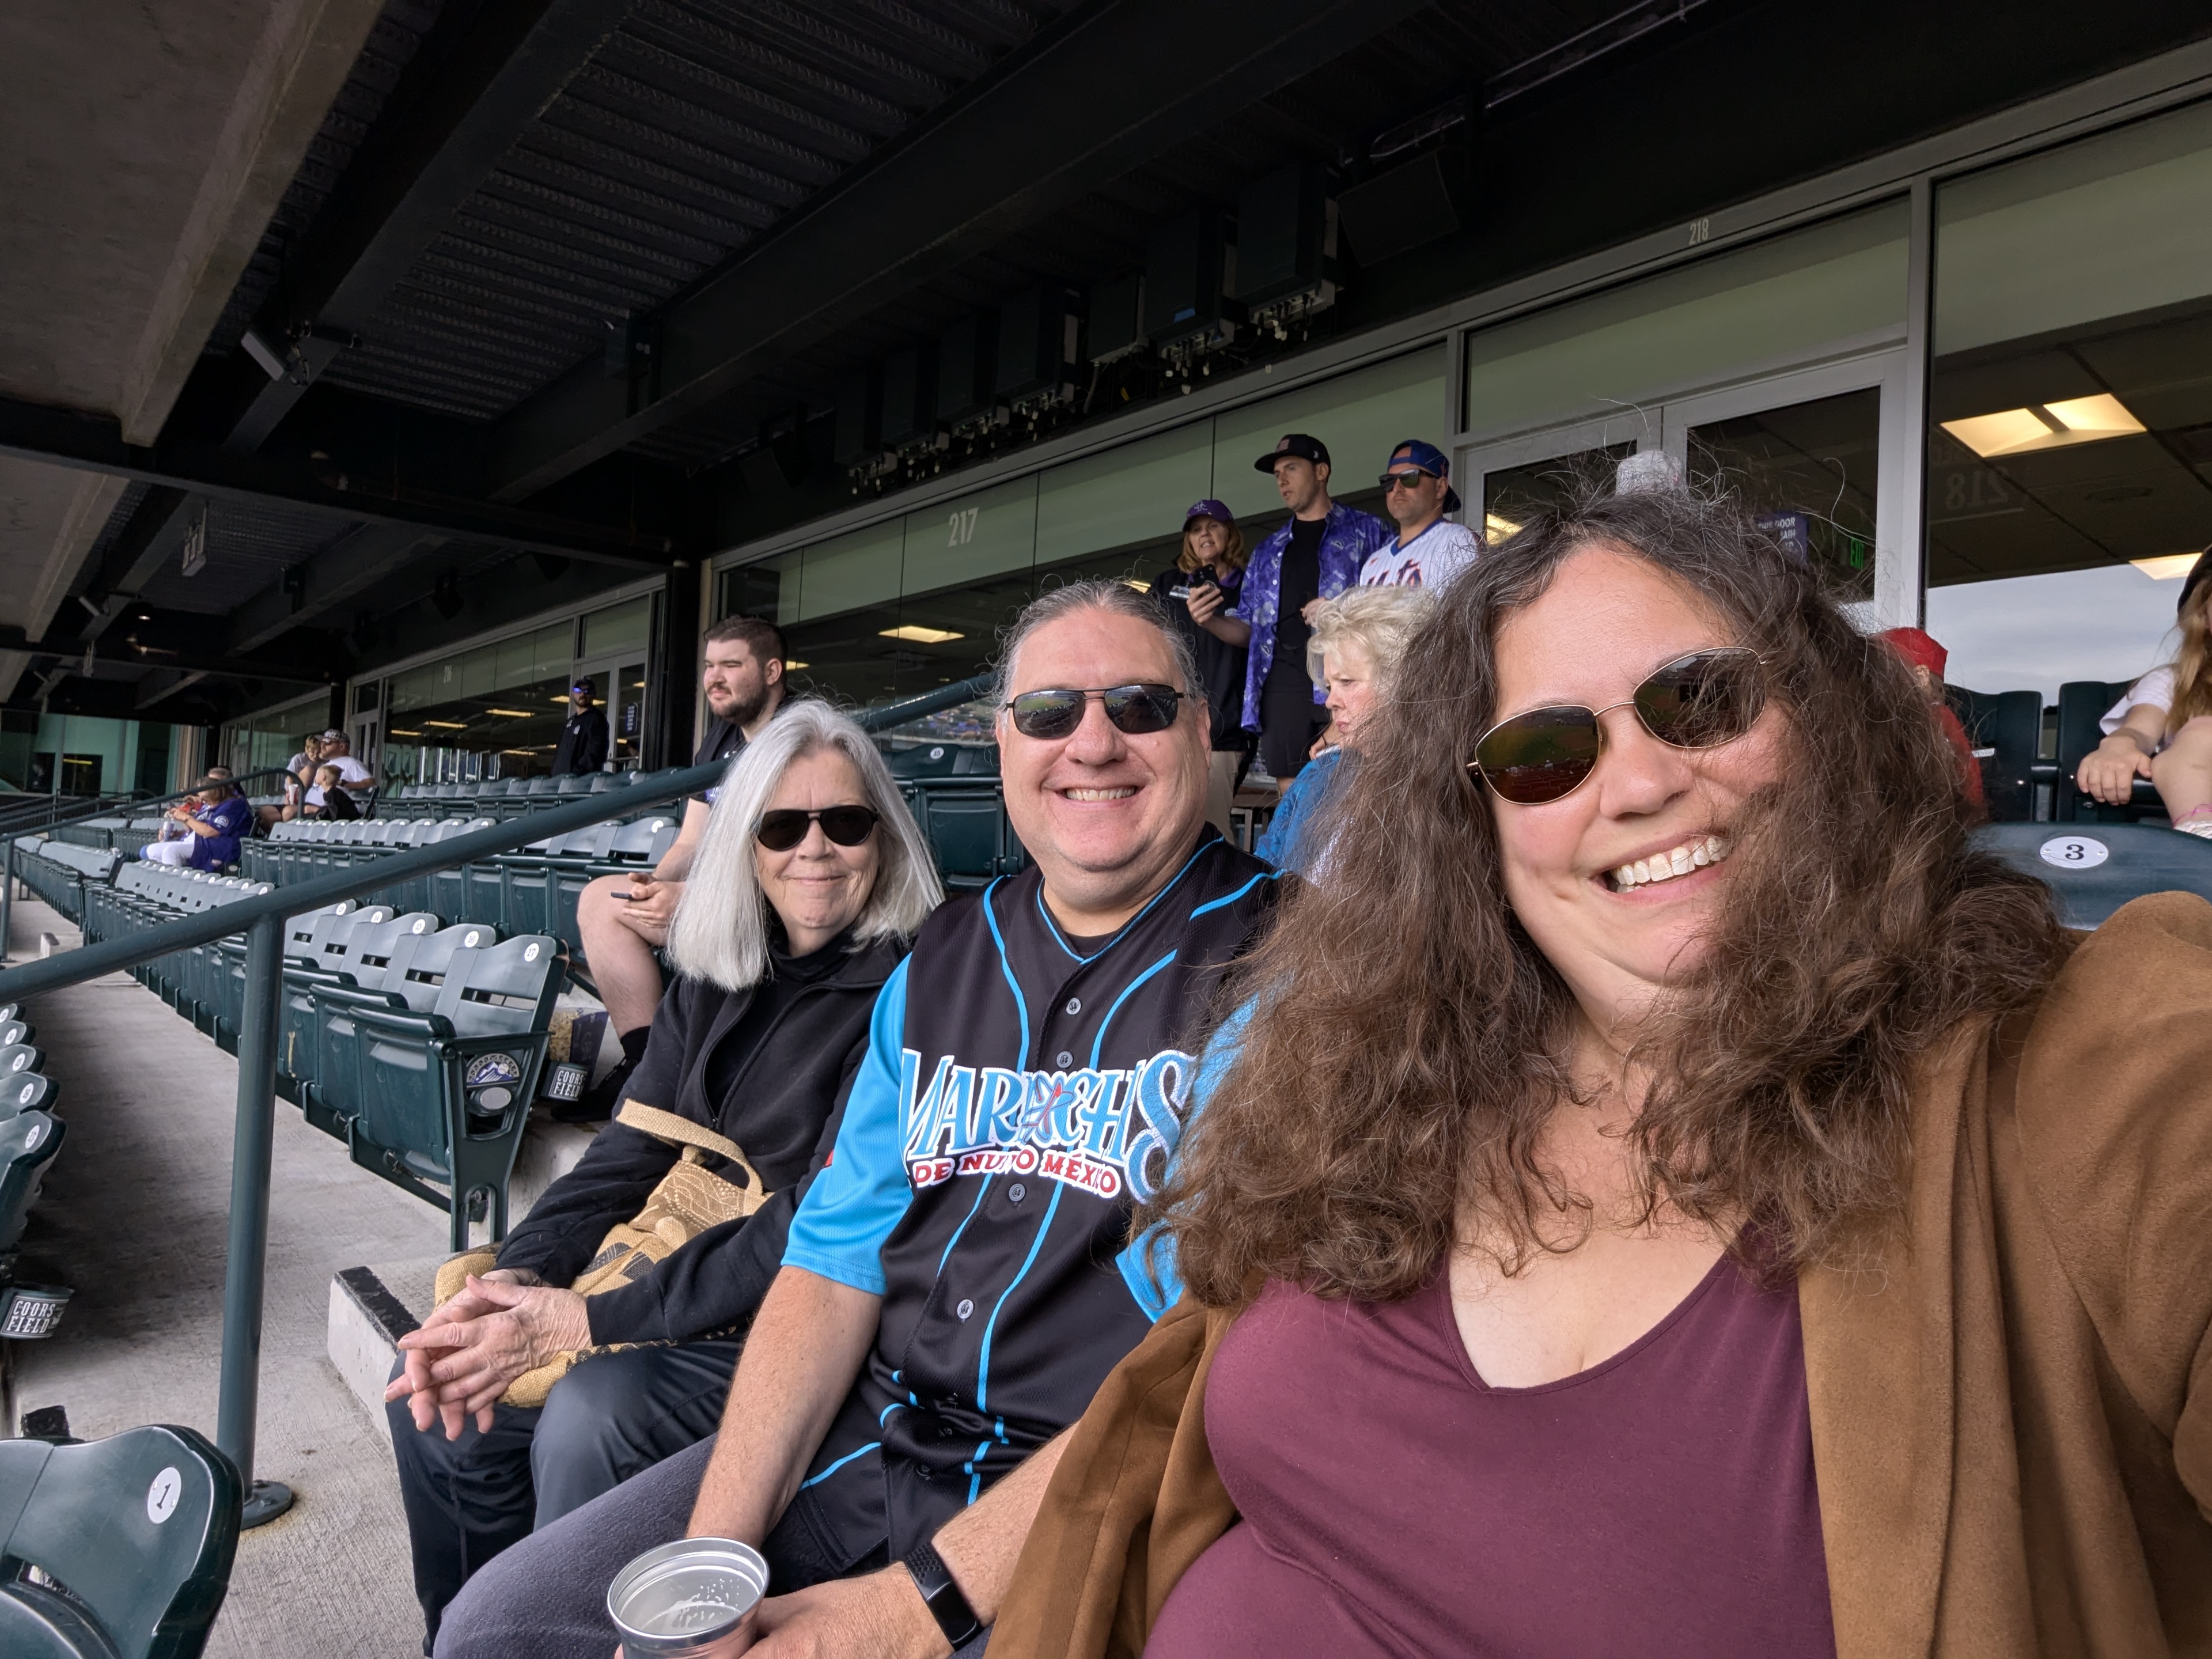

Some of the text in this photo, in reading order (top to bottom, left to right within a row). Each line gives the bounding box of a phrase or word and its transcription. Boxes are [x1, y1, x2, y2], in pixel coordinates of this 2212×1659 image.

[1689, 218, 1709, 245] 218
[948, 507, 979, 547] 217
[2065, 844, 2084, 860] 3
[467, 935, 476, 944] 16
[527, 948, 536, 957] 17
[557, 1070, 584, 1085] COORS
[554, 1081, 581, 1097] FIELD
[915, 1161, 952, 1184] DE
[13, 1301, 56, 1317] COORS
[6, 1316, 51, 1334] FIELD
[157, 1483, 171, 1510] 1
